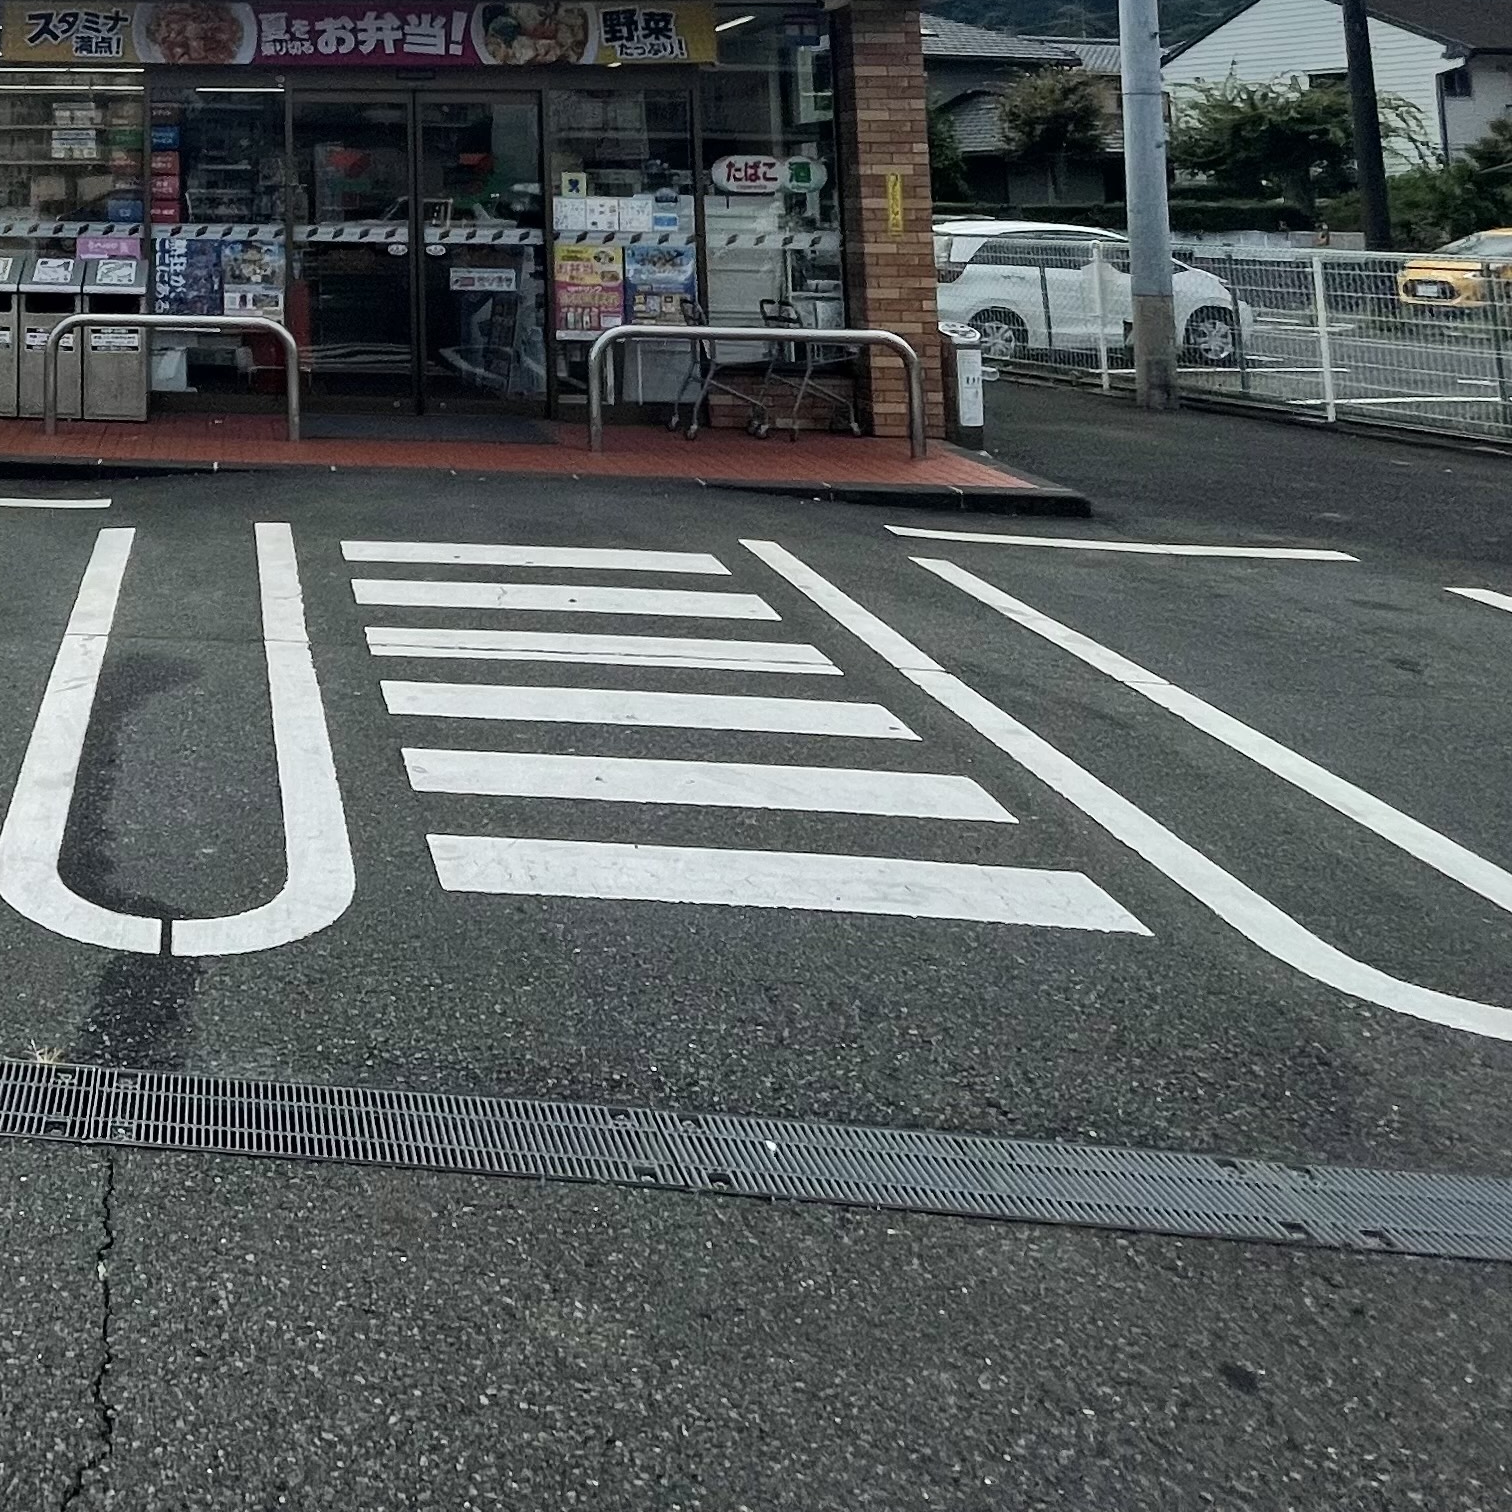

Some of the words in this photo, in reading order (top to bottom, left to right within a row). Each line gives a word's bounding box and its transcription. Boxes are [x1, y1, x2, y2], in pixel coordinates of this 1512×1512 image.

[26, 9, 130, 44] スタミナ
[314, 11, 468, 56] お弁当!
[601, 8, 675, 44] 野菜
[73, 35, 122, 56] 満点!
[616, 37, 686, 57] たっぷり!
[725, 160, 778, 183] たばこ
[788, 161, 811, 184] 酒
